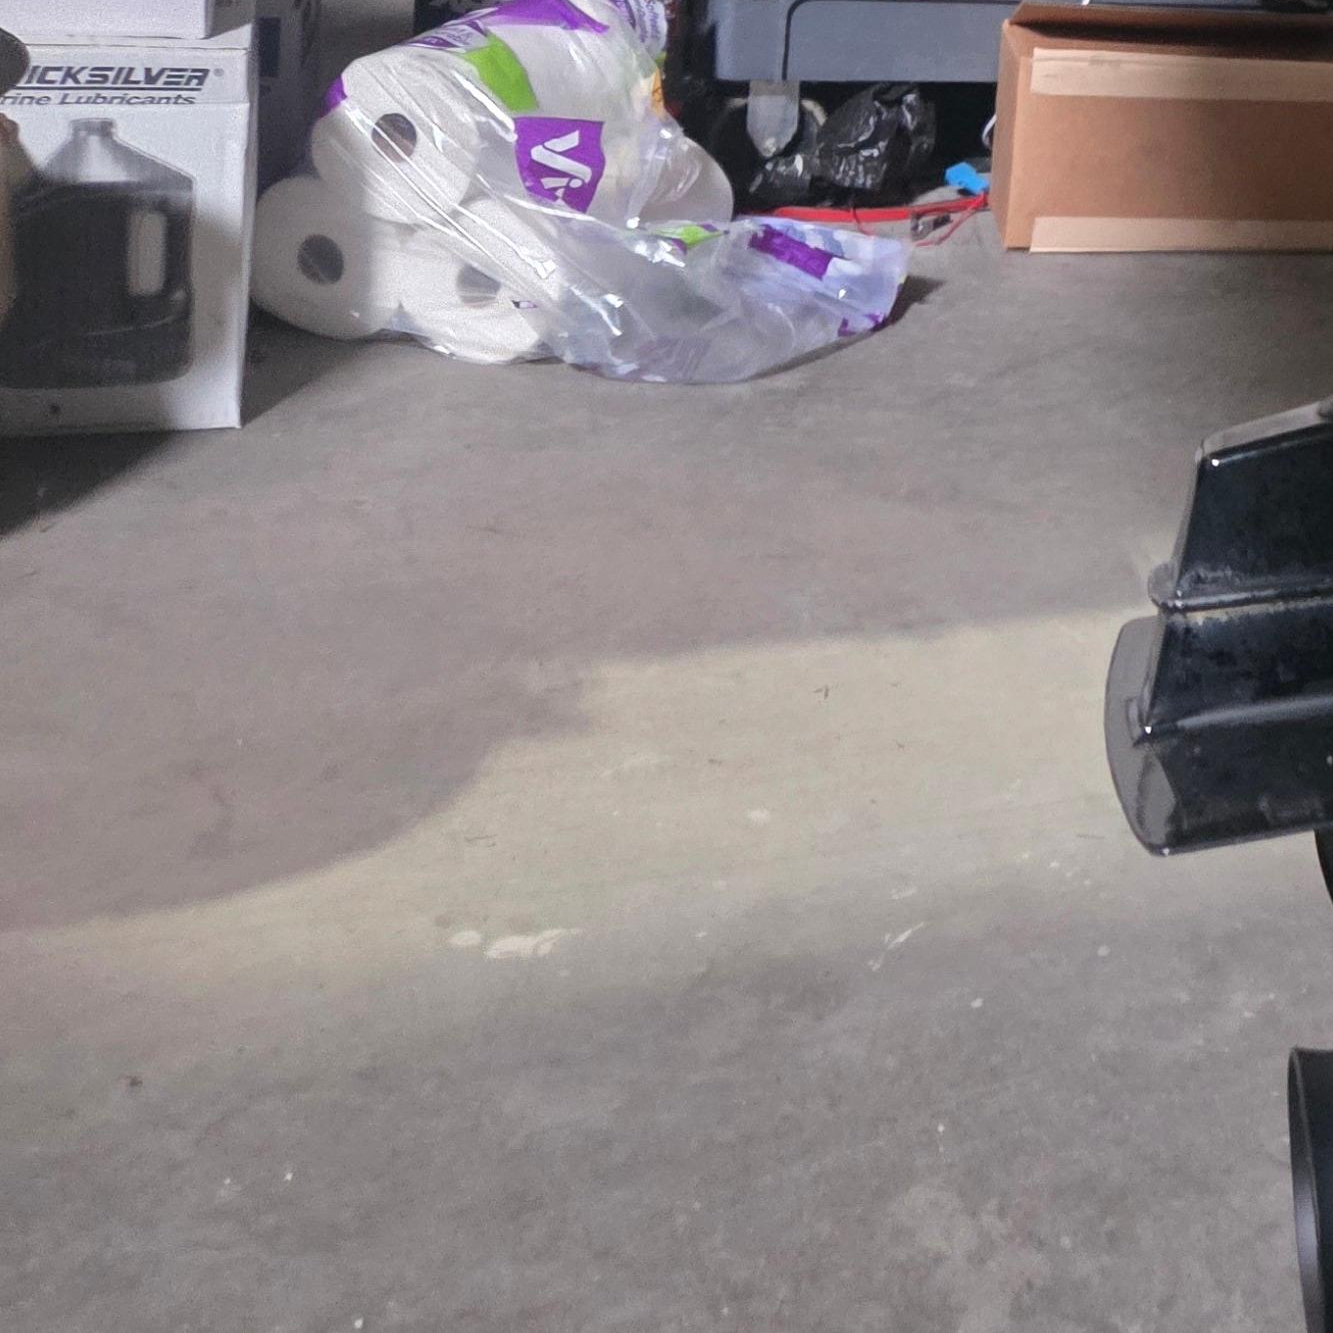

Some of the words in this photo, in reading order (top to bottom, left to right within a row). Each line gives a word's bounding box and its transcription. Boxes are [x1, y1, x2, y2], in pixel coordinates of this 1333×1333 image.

[25, 65, 209, 87] ICKSILVER
[0, 92, 52, 107] rine
[59, 92, 196, 108] Lubricants
